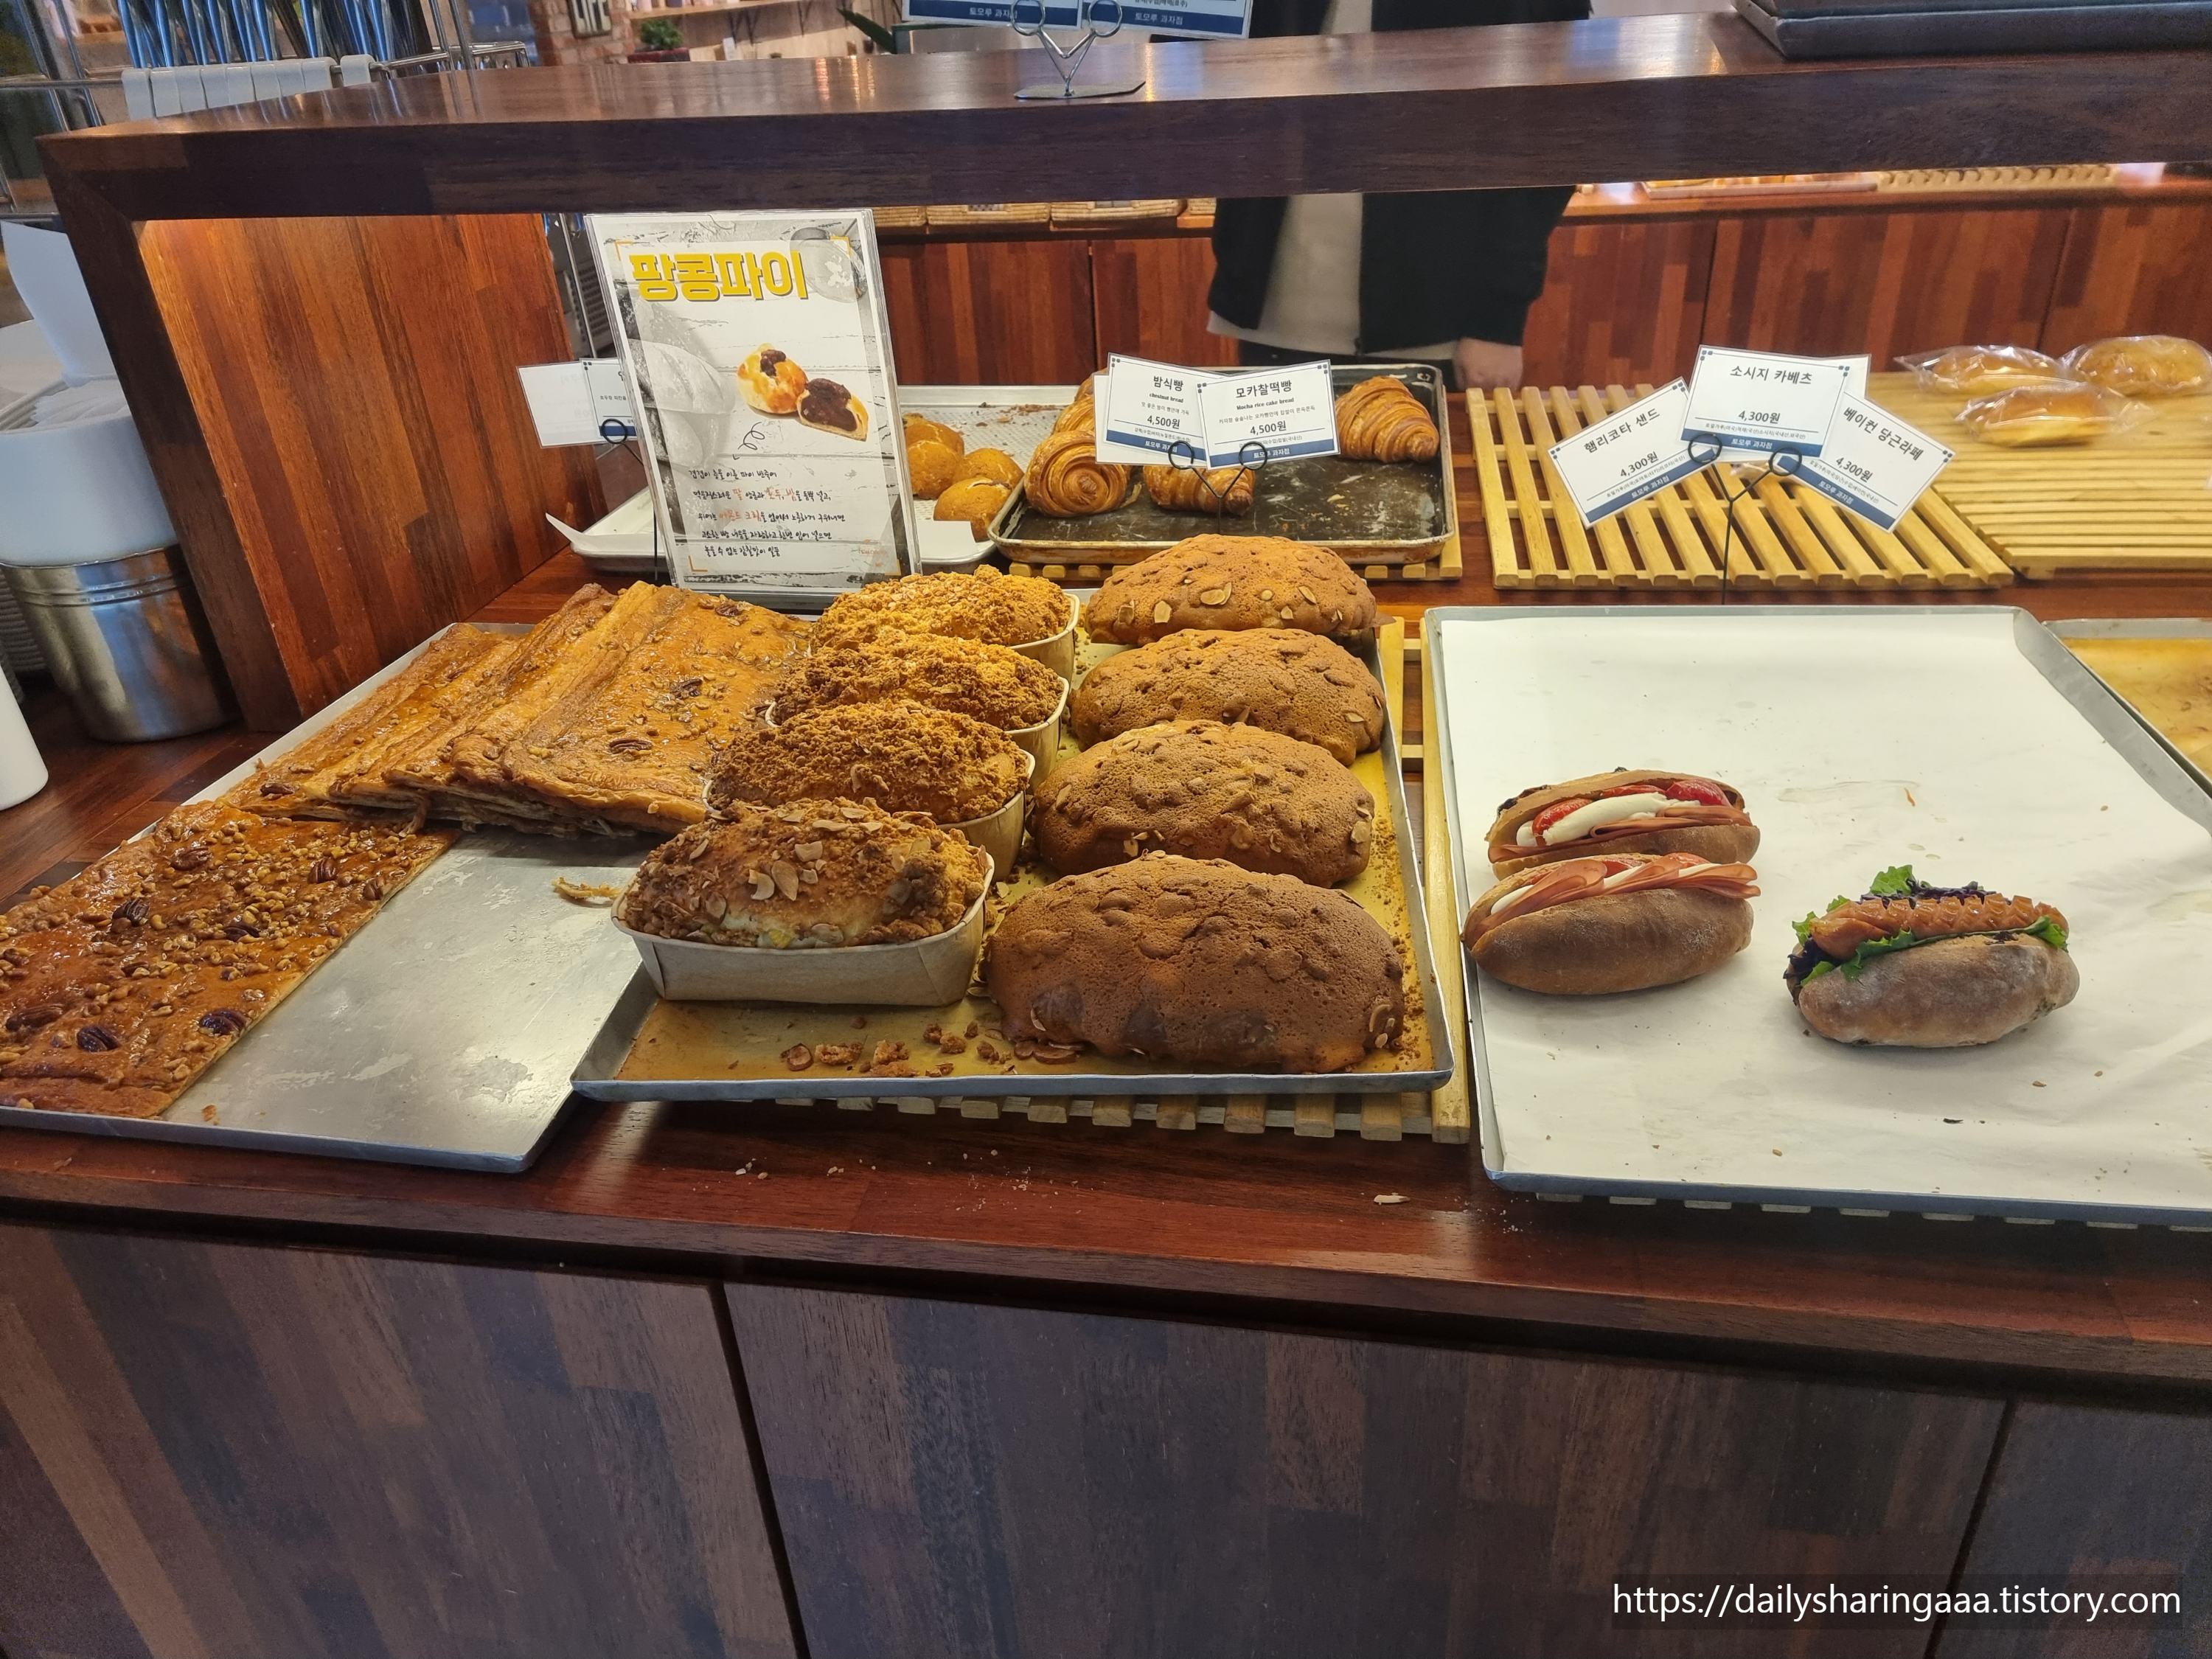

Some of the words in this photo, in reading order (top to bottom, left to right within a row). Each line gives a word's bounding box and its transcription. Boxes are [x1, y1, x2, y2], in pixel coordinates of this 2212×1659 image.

[995, 9, 1018, 18] 과자
[1161, 14, 1183, 25] 과자점
[1730, 365, 1769, 381] 소시지
[1774, 369, 1812, 385] 카베츠
[1153, 375, 1184, 392] 밤식빵
[1236, 380, 1293, 398] 모카찰떡빵
[1149, 392, 1169, 401] chestnut
[1147, 415, 1180, 429] 4,500원
[1738, 411, 1781, 425] 4,300원
[1250, 420, 1287, 436] 4,500원
[1584, 422, 1632, 453] 햄리코타
[1635, 408, 1660, 427] 샌드
[1843, 406, 1879, 434] 베이컨
[1878, 428, 1924, 461] 당근라페
[1273, 448, 1290, 456] 과자점
[1753, 441, 1773, 449] 과자점
[1620, 451, 1659, 477] 4,300원
[1836, 457, 1873, 482] 4,300원
[757, 470, 777, 480] 반죽에
[745, 490, 765, 500] 앙금과
[804, 490, 814, 501] 듬뿍
[698, 512, 717, 521] 위에는
[719, 509, 742, 521] 아몬드
[745, 509, 767, 523] 크림을
[792, 512, 815, 524] 노릇하게
[818, 513, 846, 523] 구워내면
[702, 529, 719, 539] 고소한
[720, 530, 729, 538] 빵
[750, 530, 776, 538] 자랑하고
[718, 546, 723, 556] 수
[726, 546, 738, 556] 없는
[740, 545, 766, 557] 감칠맛이
[768, 546, 780, 557] 일품
